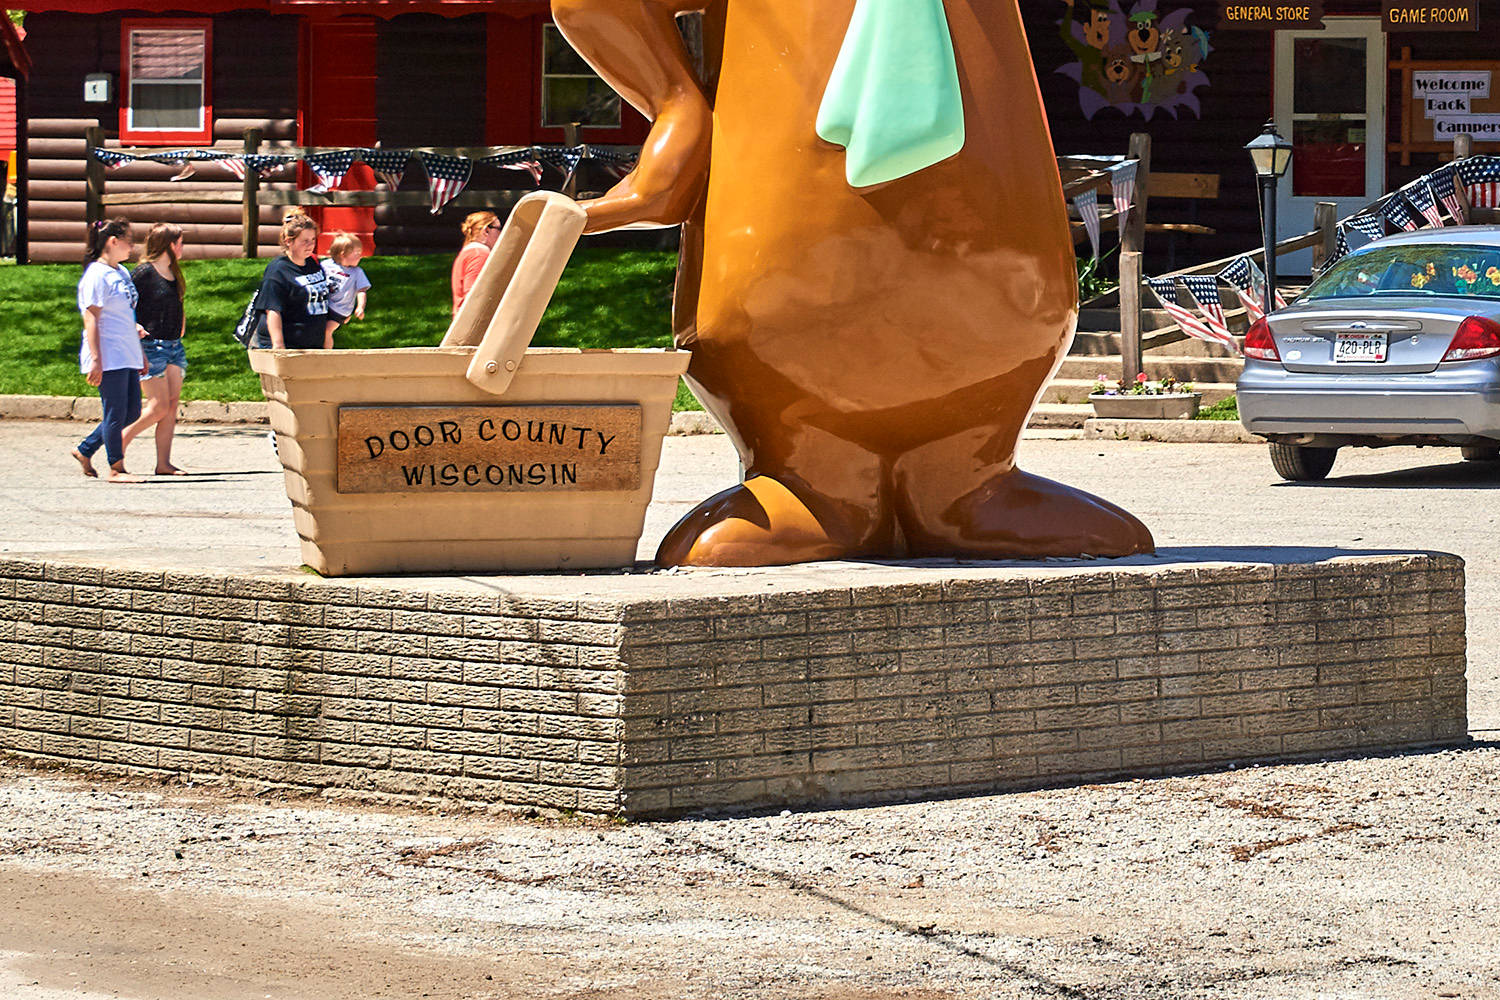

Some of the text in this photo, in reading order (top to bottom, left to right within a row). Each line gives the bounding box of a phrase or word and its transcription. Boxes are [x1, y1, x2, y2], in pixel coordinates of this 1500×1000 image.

[1226, 6, 1310, 21] GENERAL STORE
[1389, 7, 1469, 24] GAME ROOM
[1415, 79, 1485, 91] Welcome
[1427, 98, 1466, 110] Back
[1340, 340, 1381, 355] 420-PLR
[364, 419, 616, 459] DOOR COUNTY
[401, 463, 578, 486] WISCONSIN
